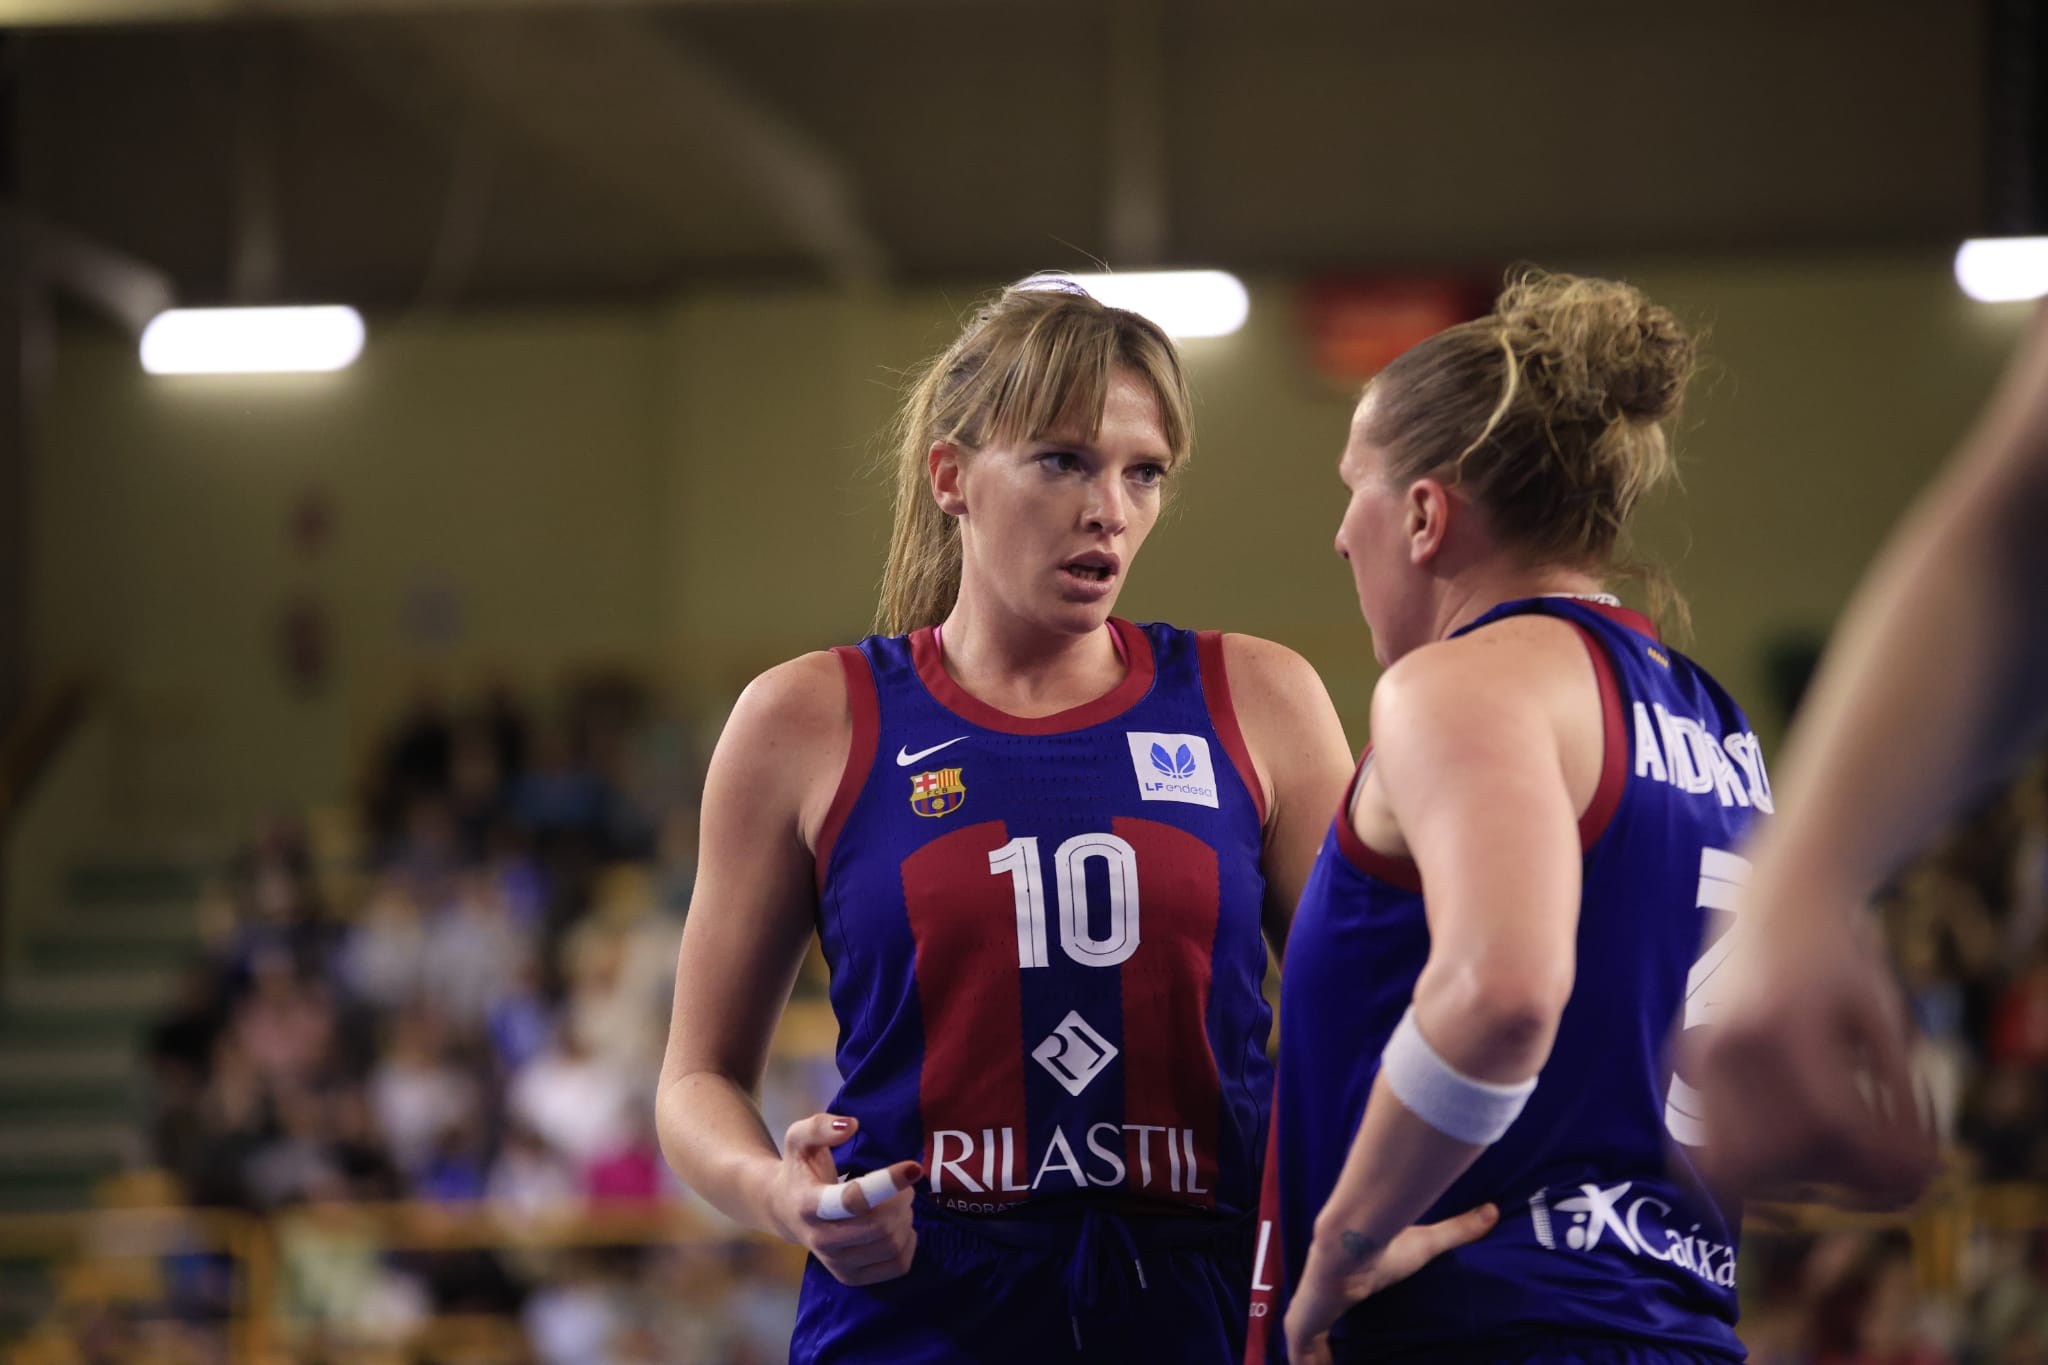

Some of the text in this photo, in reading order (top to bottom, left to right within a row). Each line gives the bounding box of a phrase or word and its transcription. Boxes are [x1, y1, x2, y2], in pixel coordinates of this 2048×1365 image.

[1145, 782, 1212, 797] LF endesa
[988, 832, 1141, 968] 10
[930, 1122, 1209, 1194] RILASTIL
